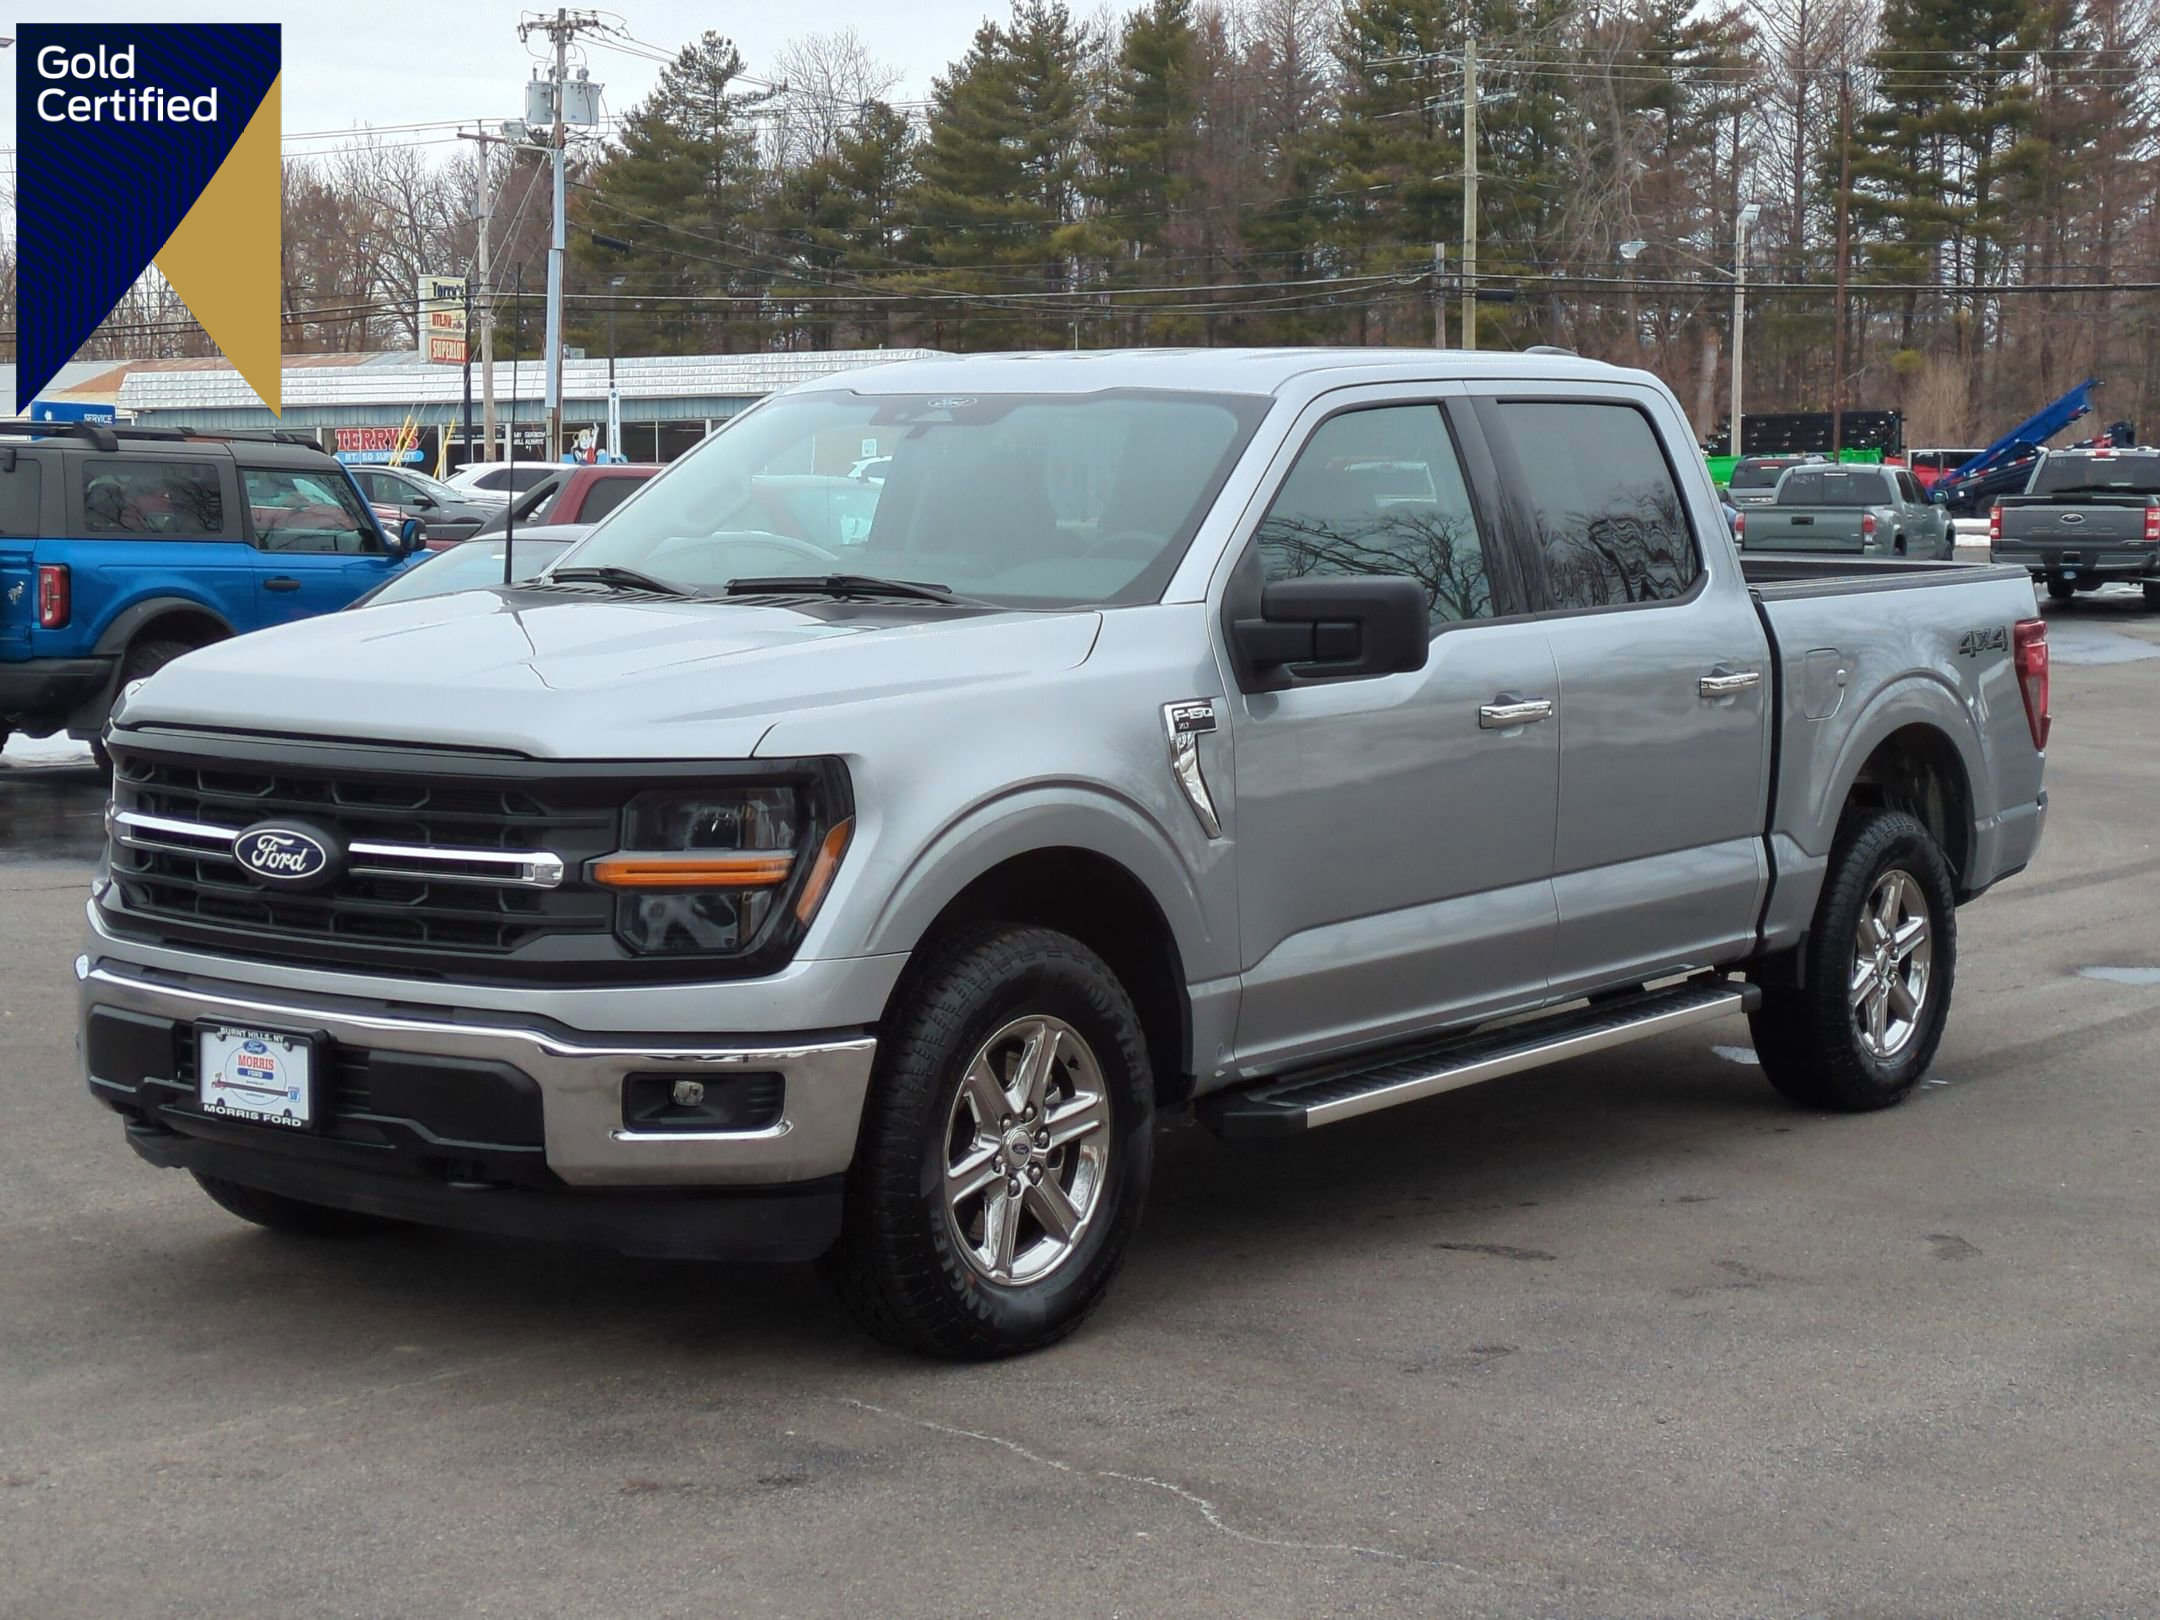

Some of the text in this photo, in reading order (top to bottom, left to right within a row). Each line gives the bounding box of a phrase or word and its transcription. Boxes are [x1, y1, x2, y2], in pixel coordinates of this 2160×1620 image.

[83, 413, 113, 424] SERVICE
[335, 428, 419, 451] TERRY'S
[1173, 707, 1214, 722] F-150
[251, 835, 307, 871] Ford
[238, 1055, 274, 1071] MORRIS
[247, 1069, 264, 1078] FORD
[203, 1104, 302, 1127] MORRIS FORD
